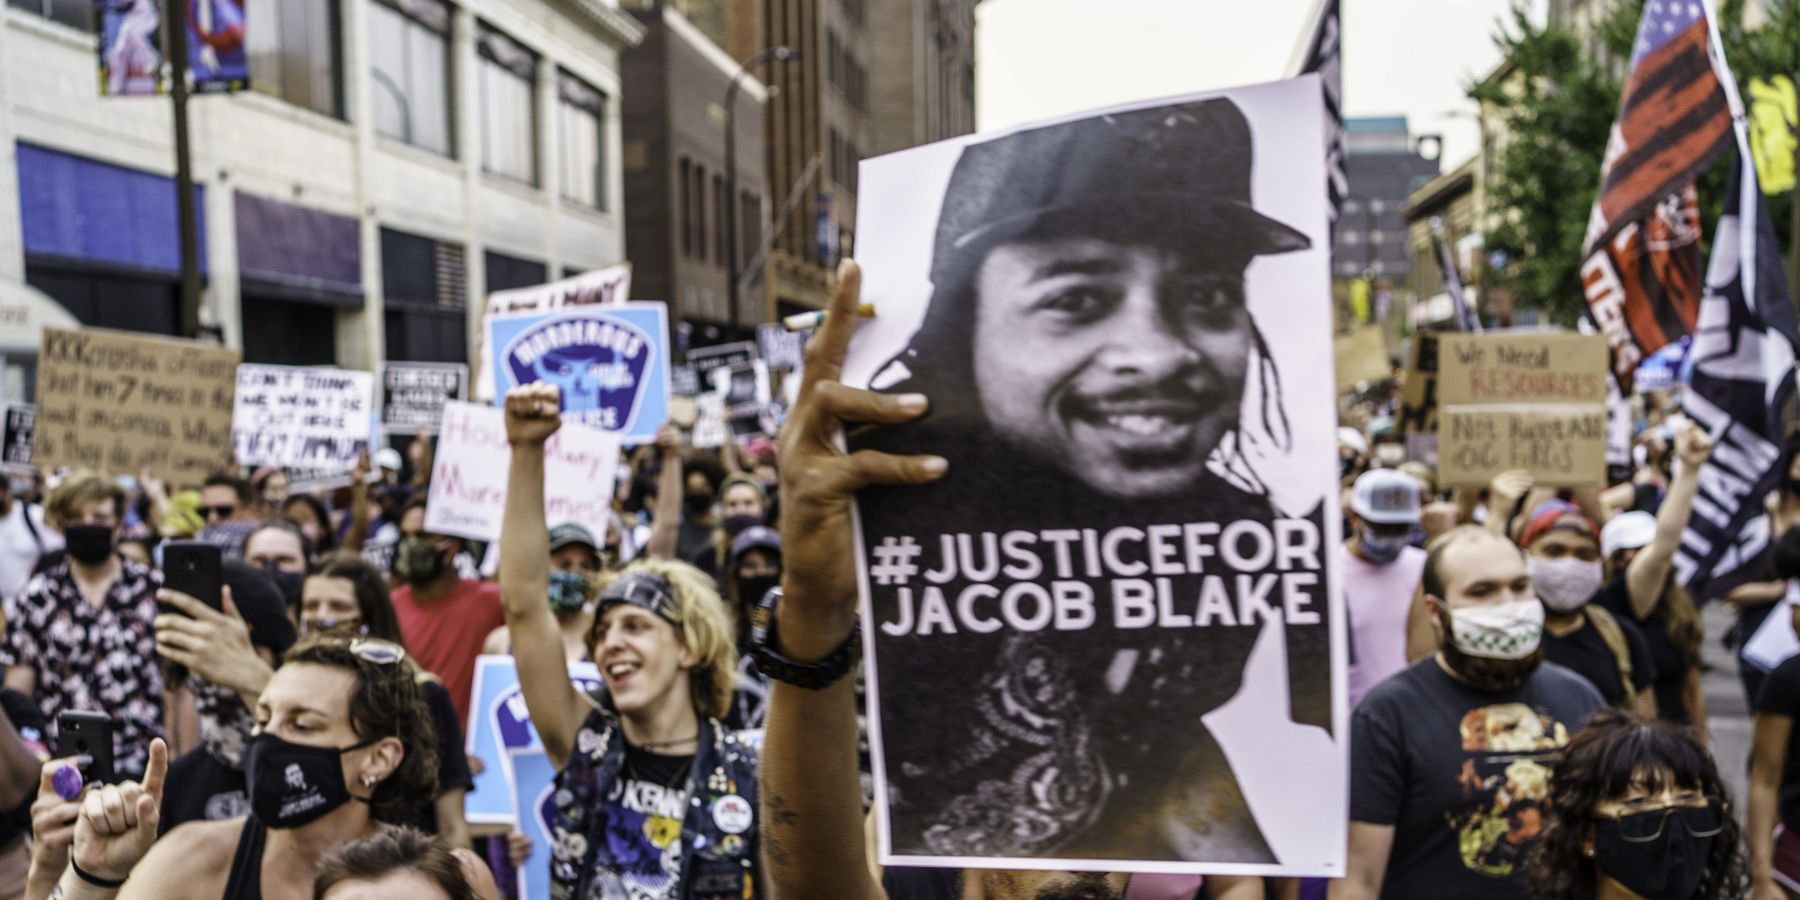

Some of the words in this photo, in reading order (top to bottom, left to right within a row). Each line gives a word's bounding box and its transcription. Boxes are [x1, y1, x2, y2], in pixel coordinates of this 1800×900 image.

[117, 375, 138, 405] 7
[870, 519, 1321, 585] #JUSTICEFOR
[880, 581, 1096, 636] JACOB
[1111, 572, 1320, 628] BLAKE
